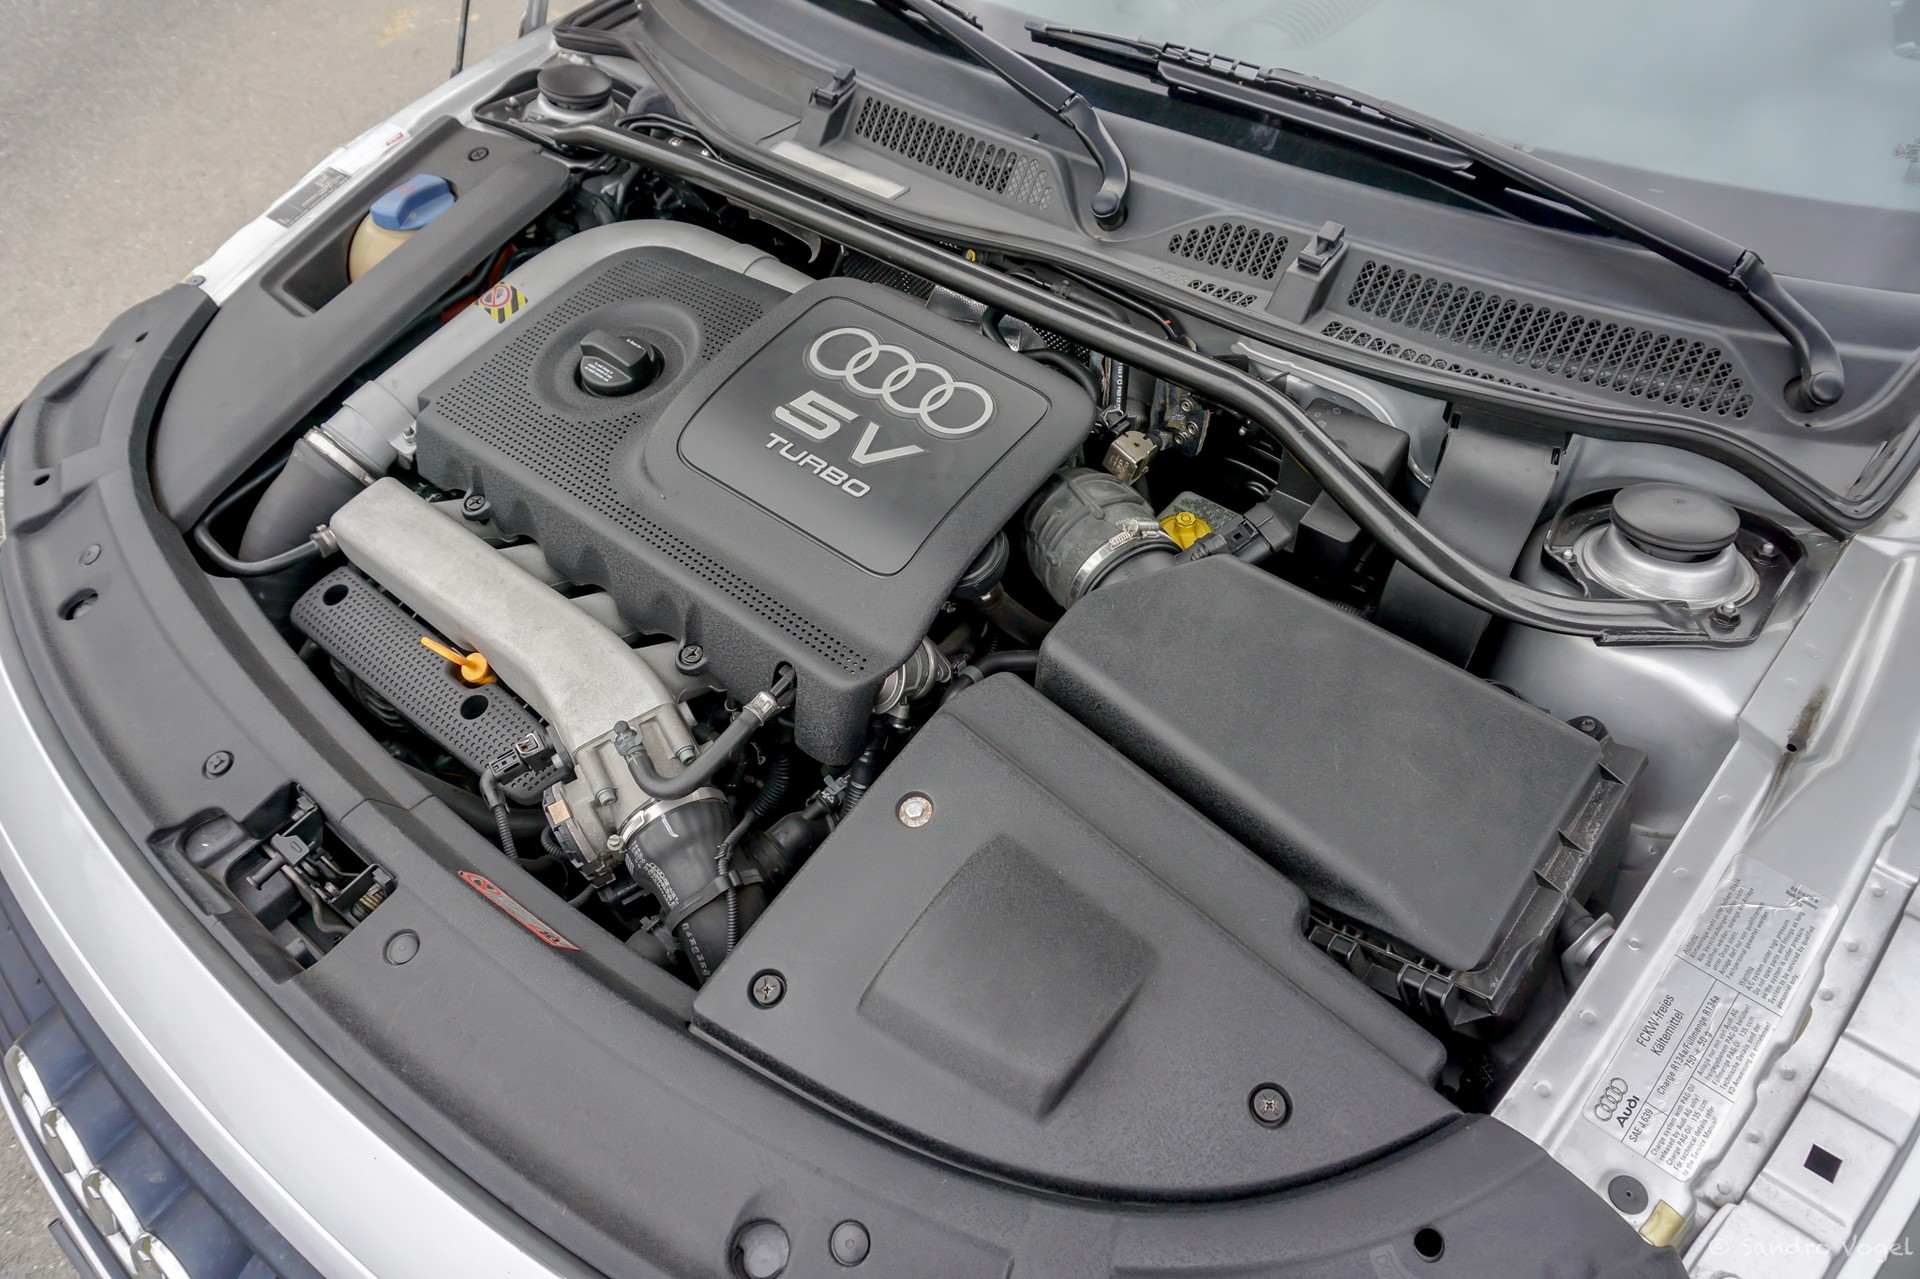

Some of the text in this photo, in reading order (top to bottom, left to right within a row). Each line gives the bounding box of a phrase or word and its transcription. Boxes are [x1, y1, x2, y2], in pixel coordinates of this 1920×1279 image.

[765, 432, 871, 498] TURBO
[1718, 942, 1730, 958] Druck
[1752, 986, 1761, 995] Do
[1757, 978, 1766, 988] not
[1762, 966, 1773, 979] open
[1769, 953, 1780, 967] parts
[1776, 943, 1785, 954] and
[1781, 927, 1795, 945] fittings
[1794, 910, 1805, 922] long
[1796, 944, 1805, 953] by
[1800, 924, 1816, 946] qualified
[1718, 957, 1732, 975] Anlage
[1737, 965, 1754, 987] Warning
[1745, 980, 1754, 991] A/C
[1750, 962, 1765, 982] system
[1760, 948, 1772, 963] under
[1768, 938, 1779, 950] high
[1764, 983, 1772, 993] the
[1769, 965, 1783, 984] system
[1781, 946, 1793, 961] under
[1781, 971, 1789, 979] be
[1785, 951, 1800, 972] serviced
[1767, 984, 1782, 1005] System
[1635, 992, 1674, 1047] FCKW-freies
[1649, 1008, 1684, 1056] Kältemittel
[1656, 993, 1720, 1096] Charge R134a/Füllmenge R134a
[1684, 1054, 1696, 1069] 750
[1697, 1035, 1707, 1046] 50
[1696, 1007, 1738, 1076] Anlage nur mit von Audi AG
[1704, 1043, 1730, 1081] freigegebenem
[1711, 1058, 1731, 1086] Füllmenge
[1738, 1026, 1748, 1037] 135
[1745, 1015, 1755, 1028] ccm
[1719, 1022, 1761, 1090] Technische Details sind der
[1727, 1057, 1752, 1096] KD-Anweisung
[1614, 1093, 1640, 1128] Audi
[1628, 1107, 1653, 1143] SAE J 639
[1650, 1135, 1666, 1157] Charge
[1661, 1116, 1678, 1138] system
[1672, 1102, 1683, 1117] with
[1658, 1093, 1701, 1161] released by Audi AG only!
[1665, 1145, 1682, 1167] Charge
[1690, 1110, 1701, 1122] 135
[1697, 1098, 1708, 1111] ccm
[1673, 1104, 1714, 1171] For technical details refer
[1681, 1168, 1689, 1176] to
[1685, 1158, 1694, 1169] the
[1690, 1137, 1706, 1159] Service
